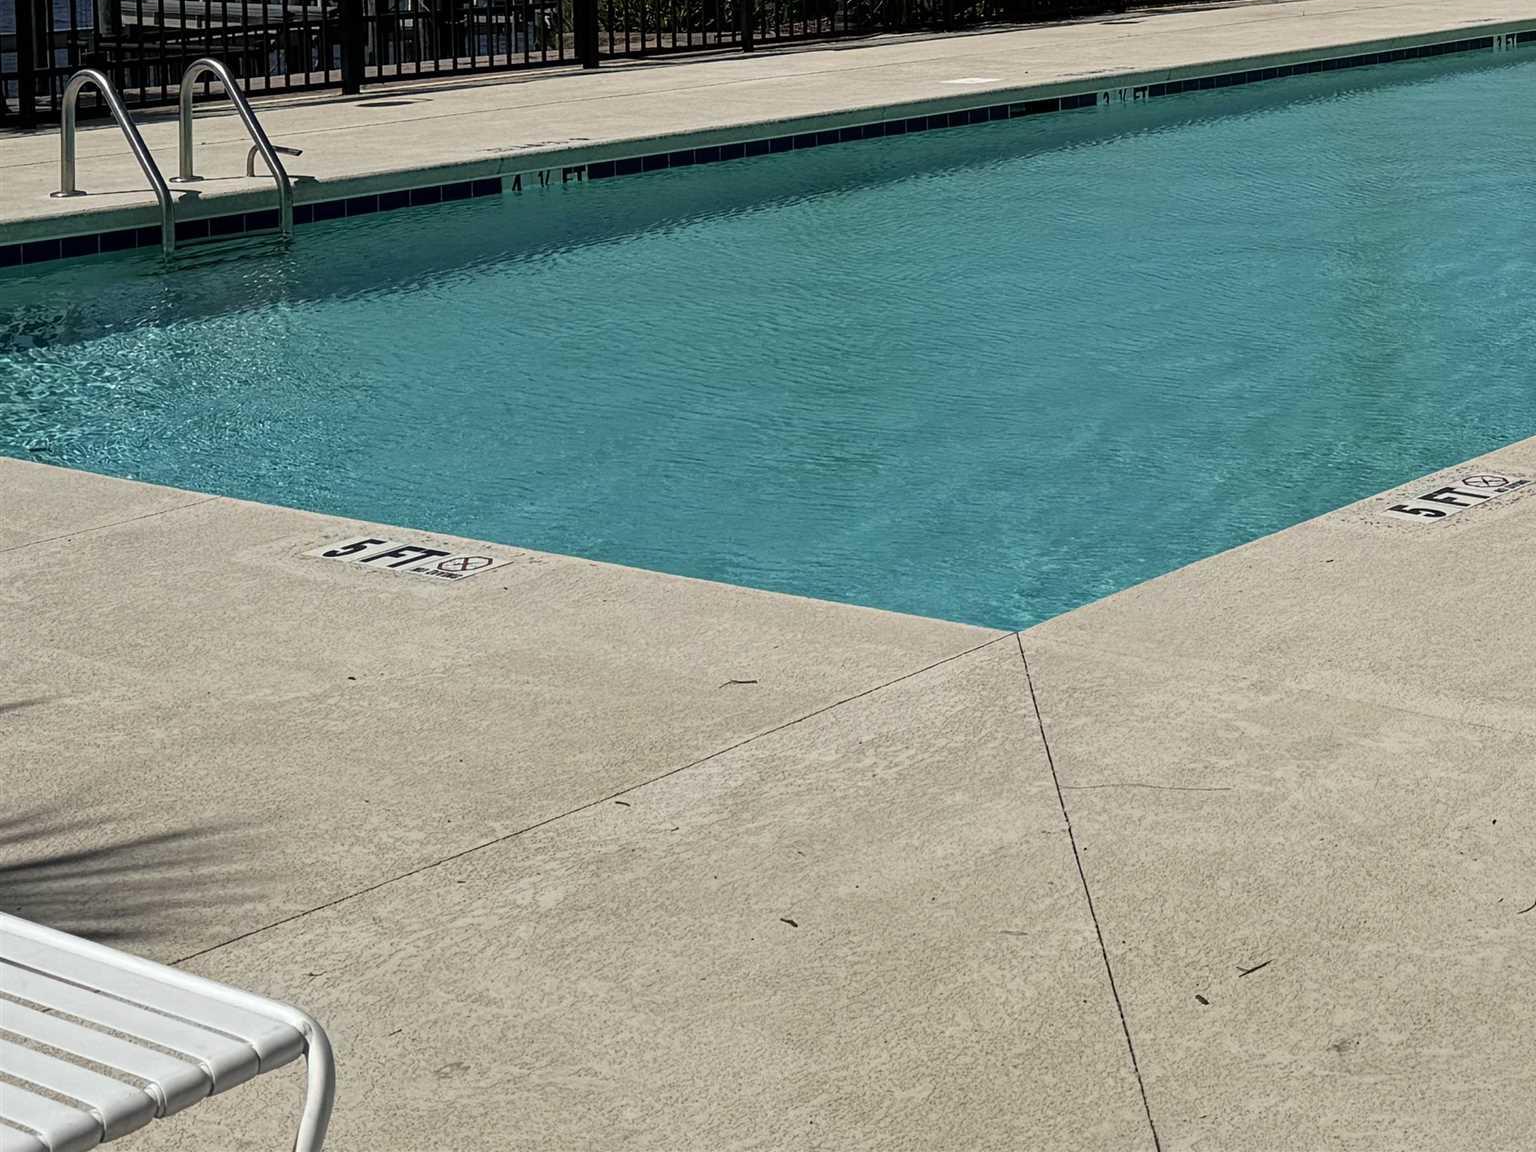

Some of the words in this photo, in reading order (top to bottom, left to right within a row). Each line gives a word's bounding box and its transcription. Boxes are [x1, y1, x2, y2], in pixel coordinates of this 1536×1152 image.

[563, 165, 585, 183] FT
[1387, 504, 1447, 518] 5
[1418, 486, 1490, 507] FT
[322, 538, 387, 557] 5
[360, 546, 451, 568] FT
